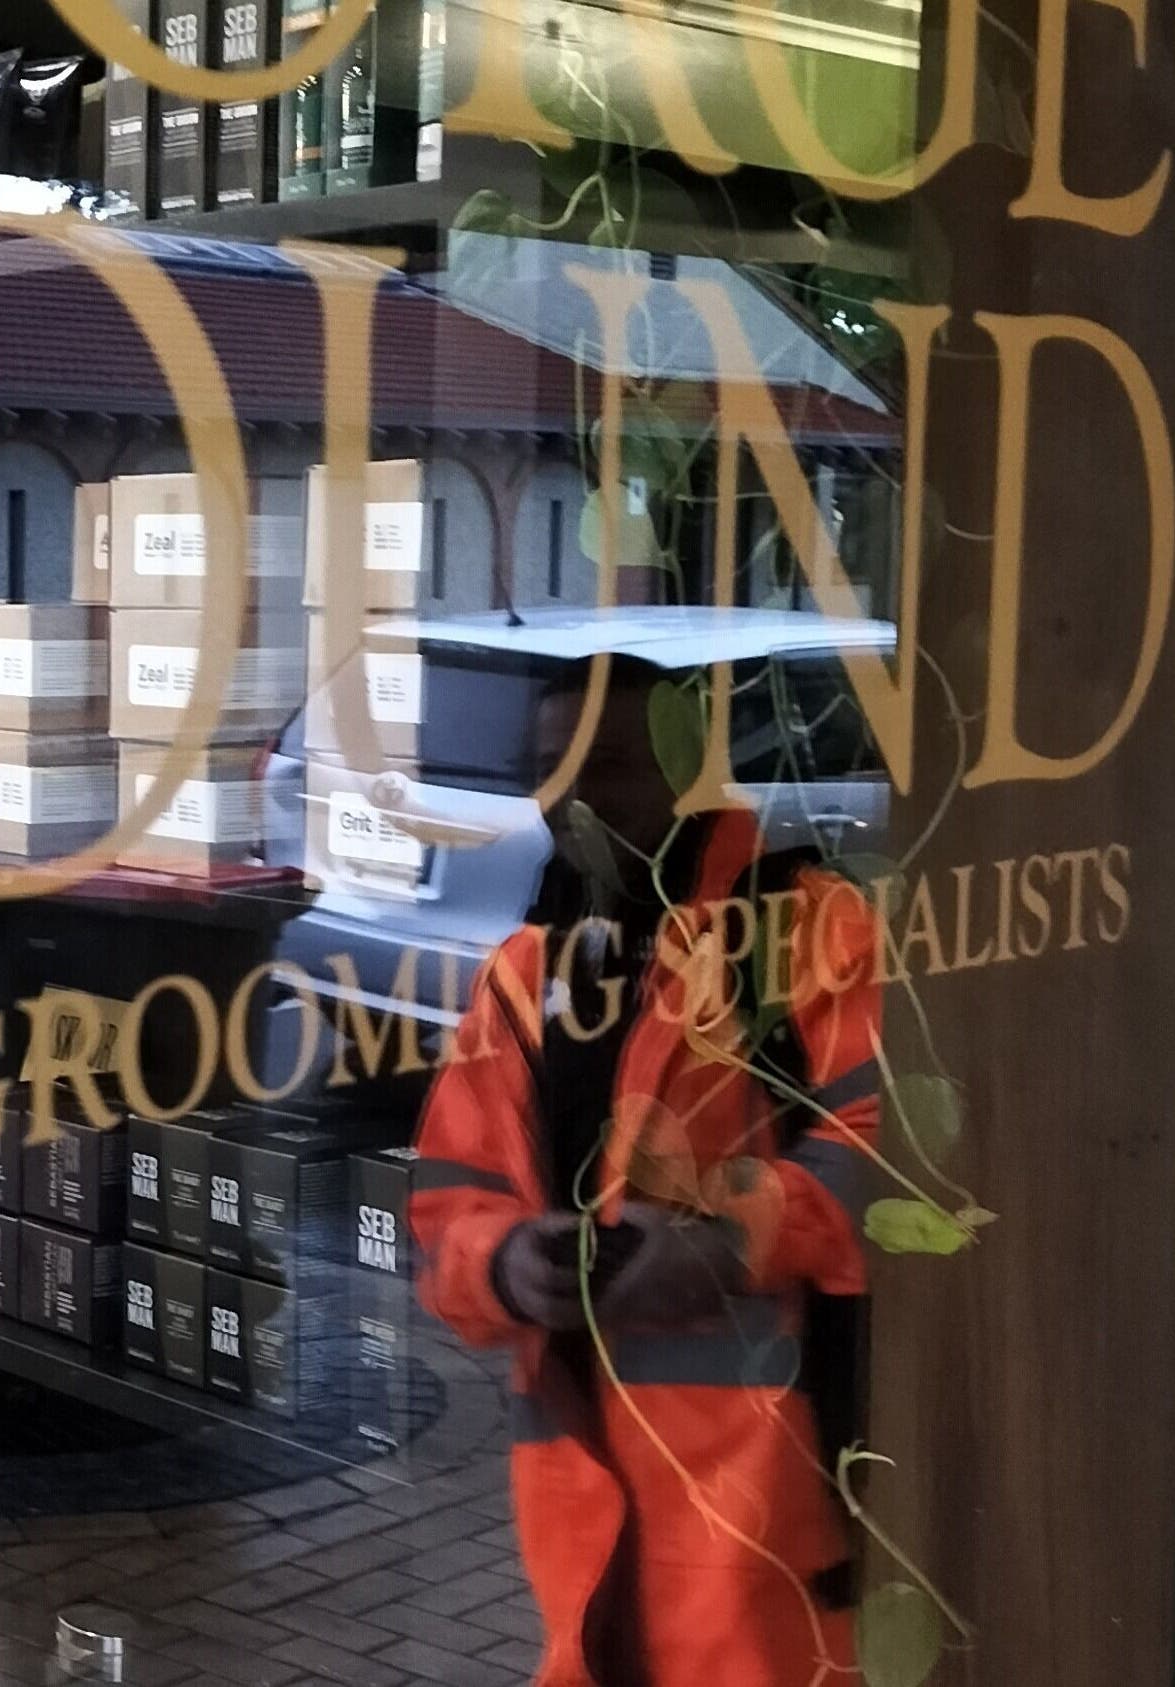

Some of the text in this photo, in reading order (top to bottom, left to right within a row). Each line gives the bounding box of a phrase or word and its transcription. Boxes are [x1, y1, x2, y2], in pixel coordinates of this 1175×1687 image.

[165, 14, 197, 45] SEB
[224, 3, 257, 37] SEB
[223, 33, 257, 63] MAN
[143, 531, 177, 551] Zeal
[137, 662, 169, 683] Zeal
[340, 809, 374, 833] Grit
[655, 843, 1132, 1024] SPECIALISTS
[132, 1152, 159, 1179] SEB
[131, 1175, 160, 1201] MAN
[211, 1176, 240, 1203] SEB
[210, 1199, 241, 1226] MAN
[358, 1205, 397, 1243] SEB
[357, 1236, 396, 1273] MAN
[127, 1280, 154, 1308] SEB
[127, 1303, 156, 1330] MAN
[211, 1306, 240, 1335] SEB
[210, 1330, 242, 1359] MAN
